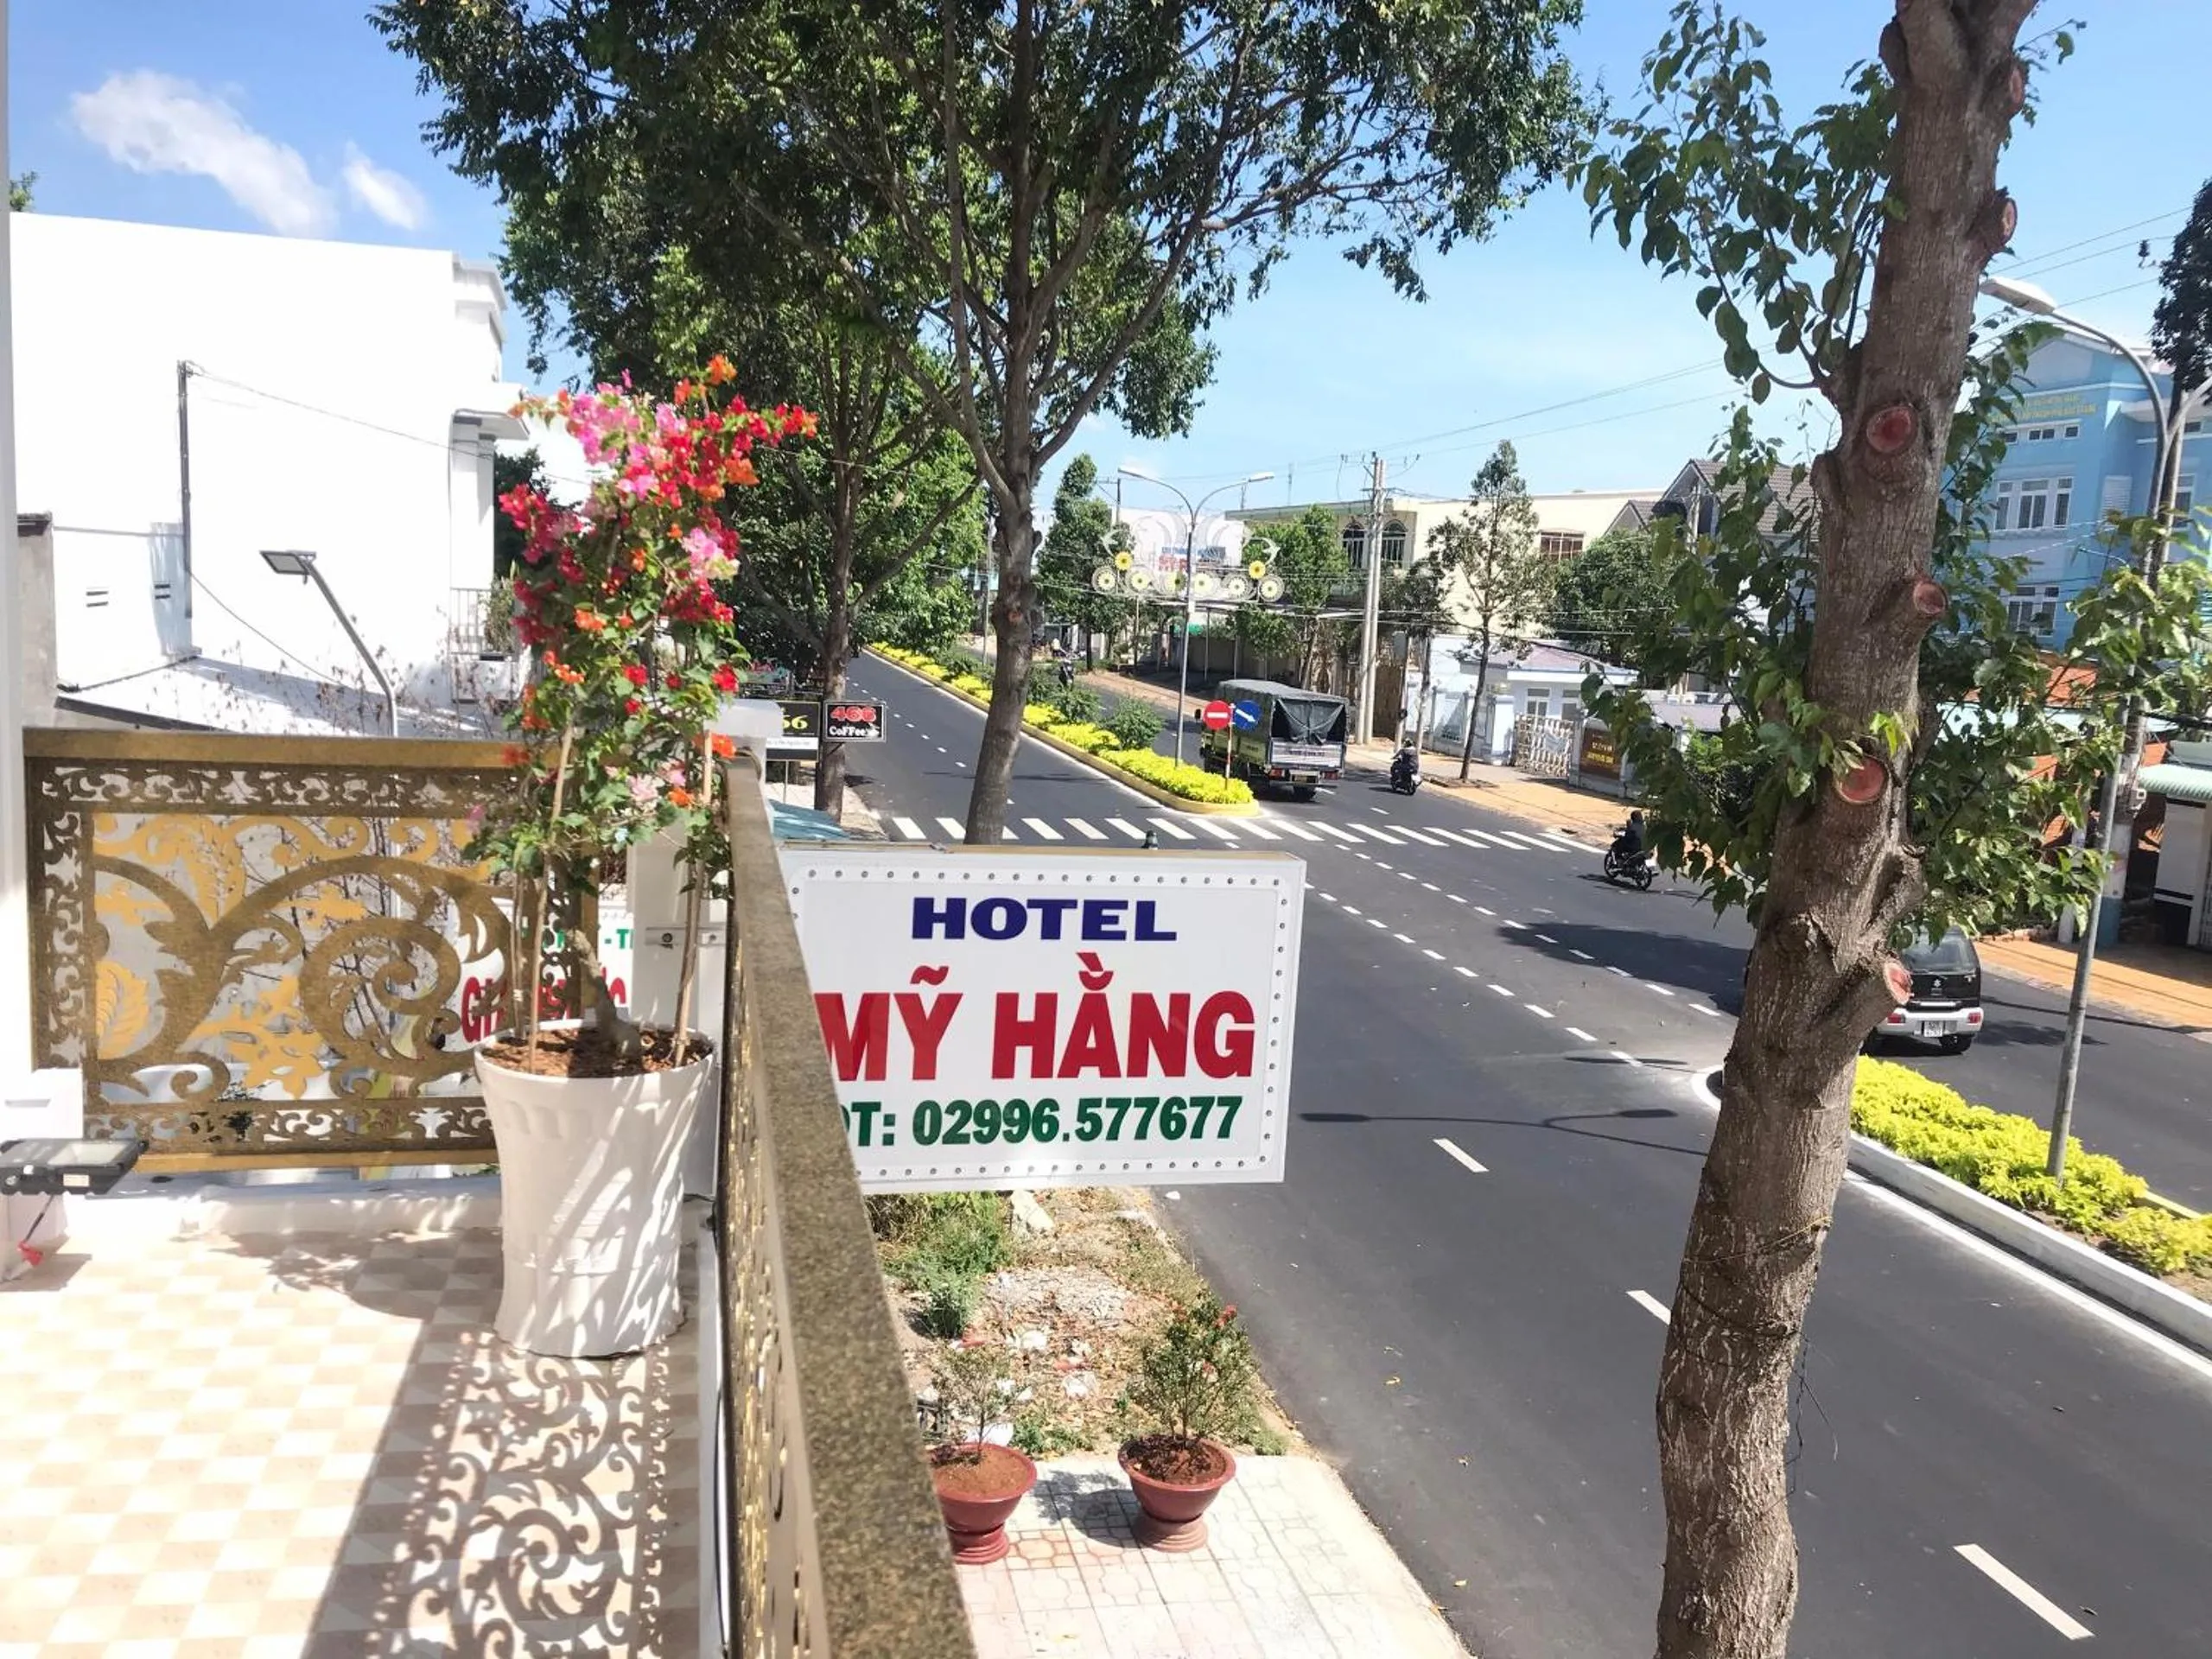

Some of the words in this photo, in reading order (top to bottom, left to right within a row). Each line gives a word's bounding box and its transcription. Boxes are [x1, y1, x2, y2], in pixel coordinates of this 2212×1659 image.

[912, 897, 1177, 942] HOTEL
[814, 965, 963, 1081] MỸ
[991, 952, 1255, 1079] HẰNG
[840, 1100, 896, 1147] T:
[912, 1096, 1243, 1147] 02996.577677
